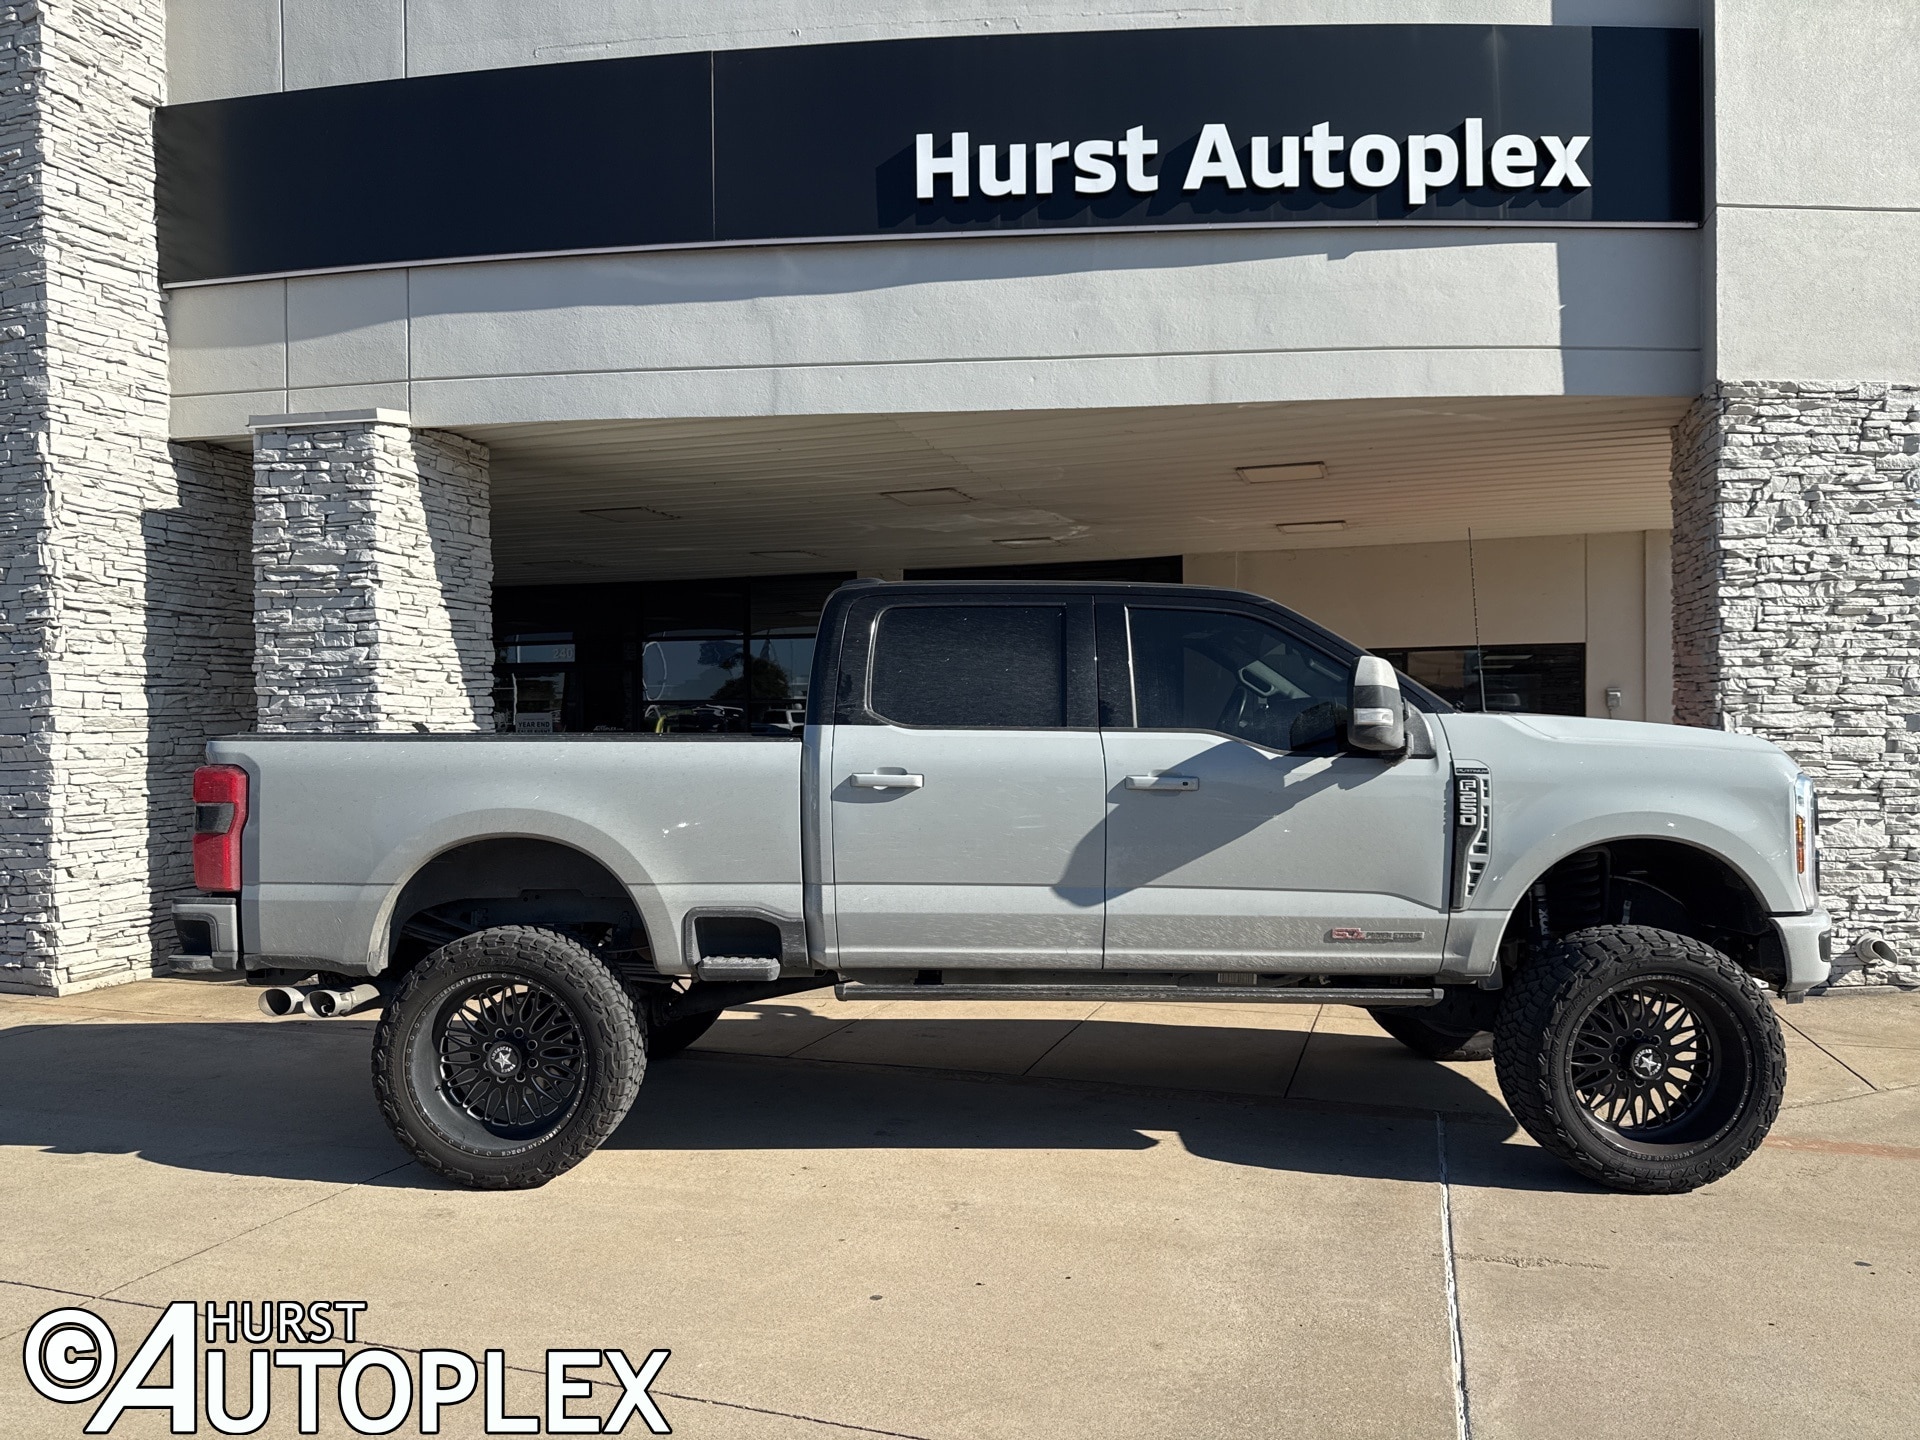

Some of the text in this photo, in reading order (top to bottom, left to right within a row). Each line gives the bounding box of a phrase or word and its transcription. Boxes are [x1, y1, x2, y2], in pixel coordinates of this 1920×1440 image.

[917, 118, 1591, 204] Hurst Autoplex
[1459, 779, 1477, 826] F250
[466, 972, 491, 982] FORCE
